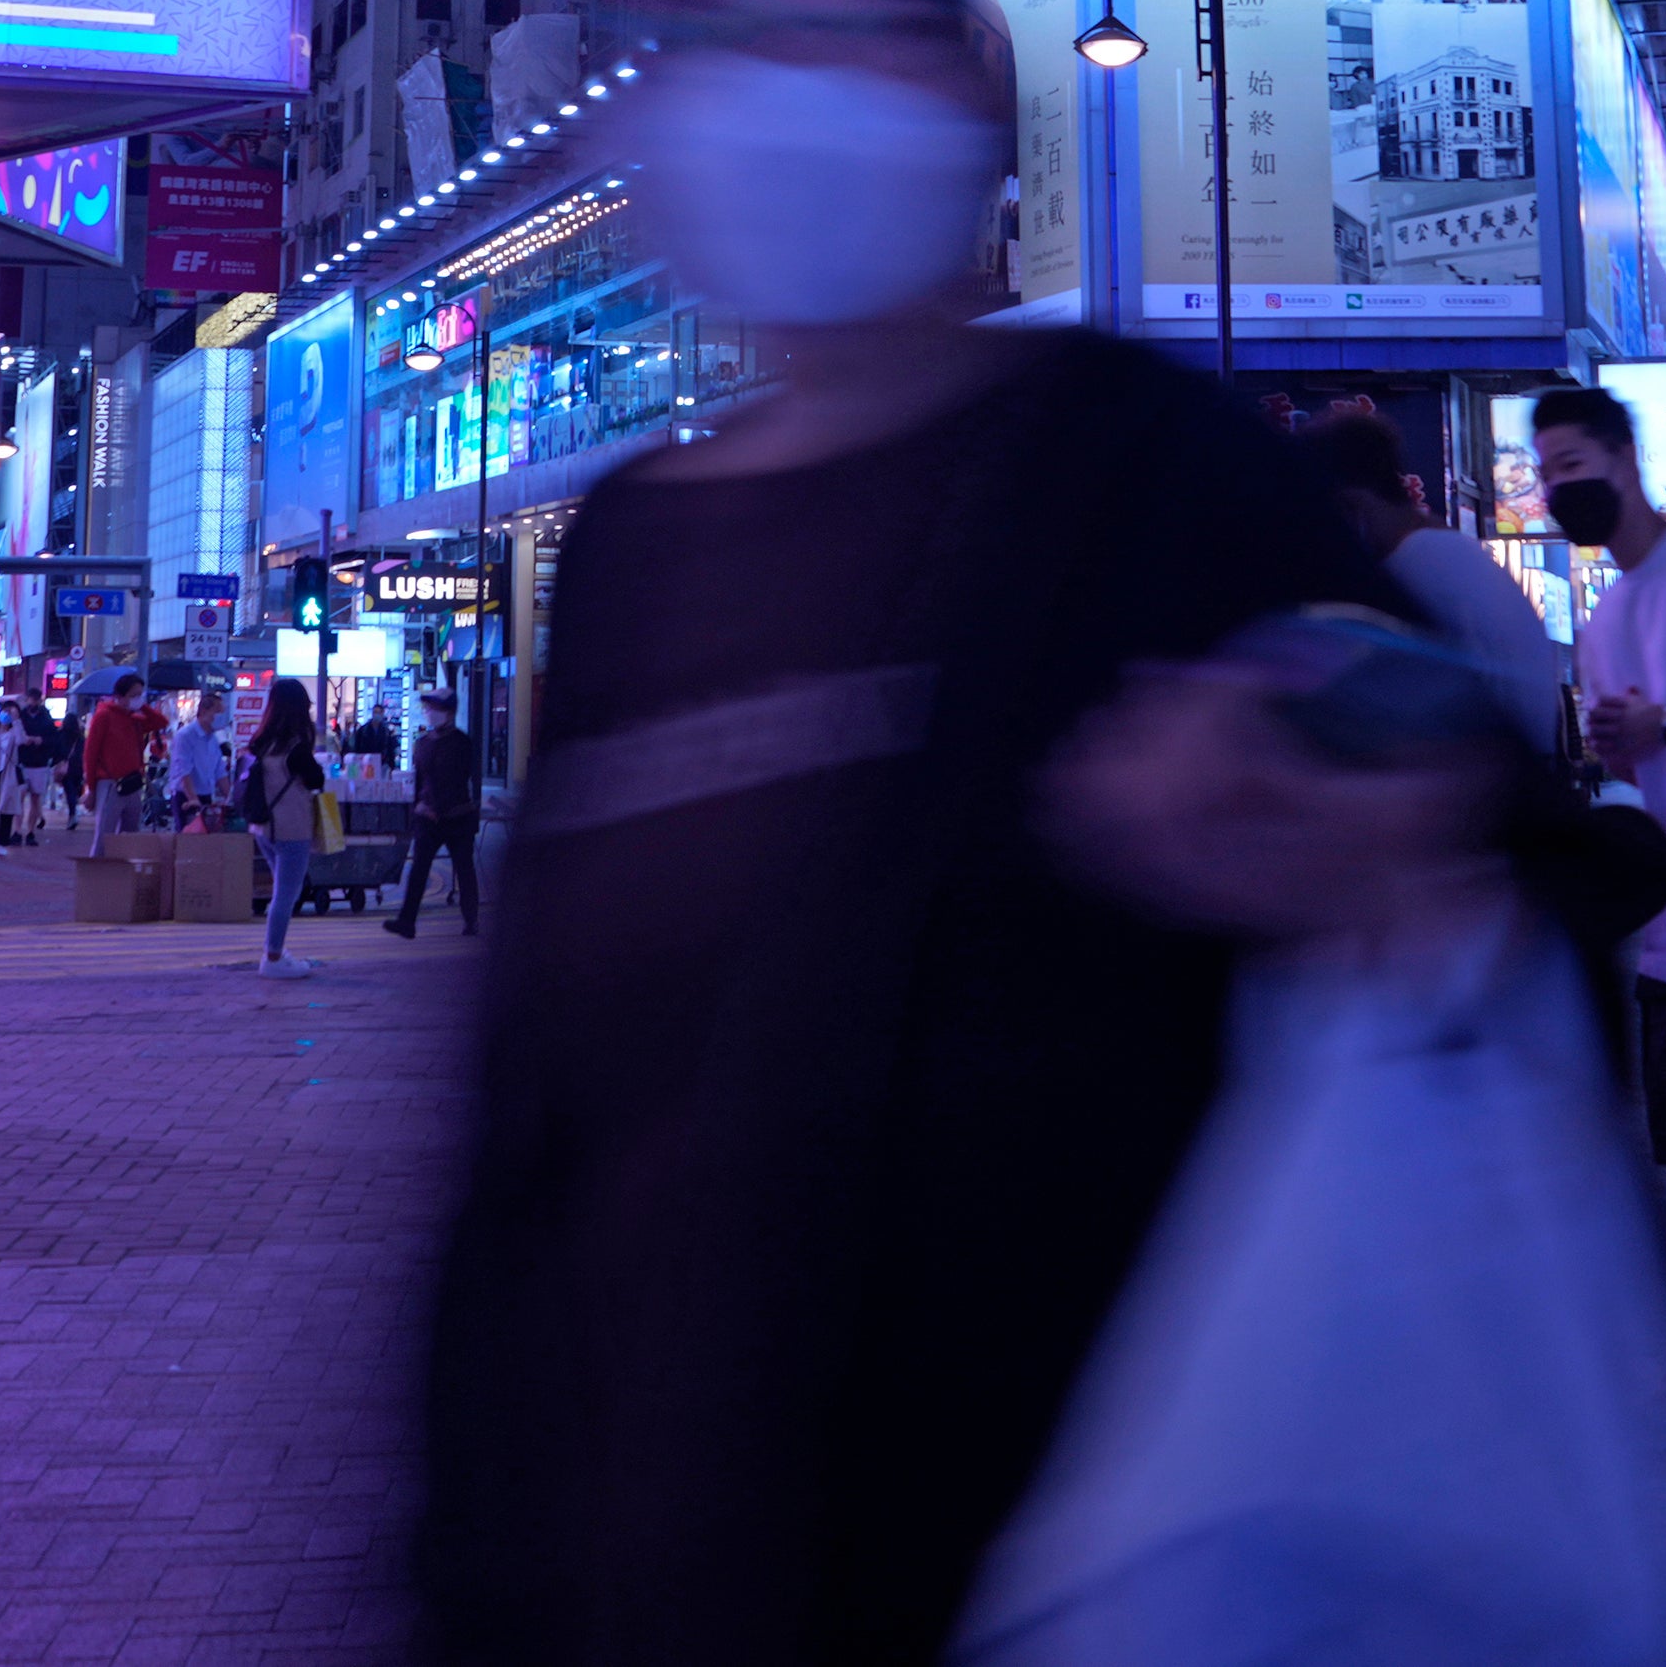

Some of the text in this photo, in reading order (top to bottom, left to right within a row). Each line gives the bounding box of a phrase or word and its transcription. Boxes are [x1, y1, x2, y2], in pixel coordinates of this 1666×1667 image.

[1247, 70, 1277, 205] 始終如一
[172, 250, 209, 272] EF
[92, 377, 111, 488] FASHION WALK
[379, 576, 455, 600] LUSH
[190, 634, 223, 643] 24 hrs
[193, 645, 219, 657] 全日
